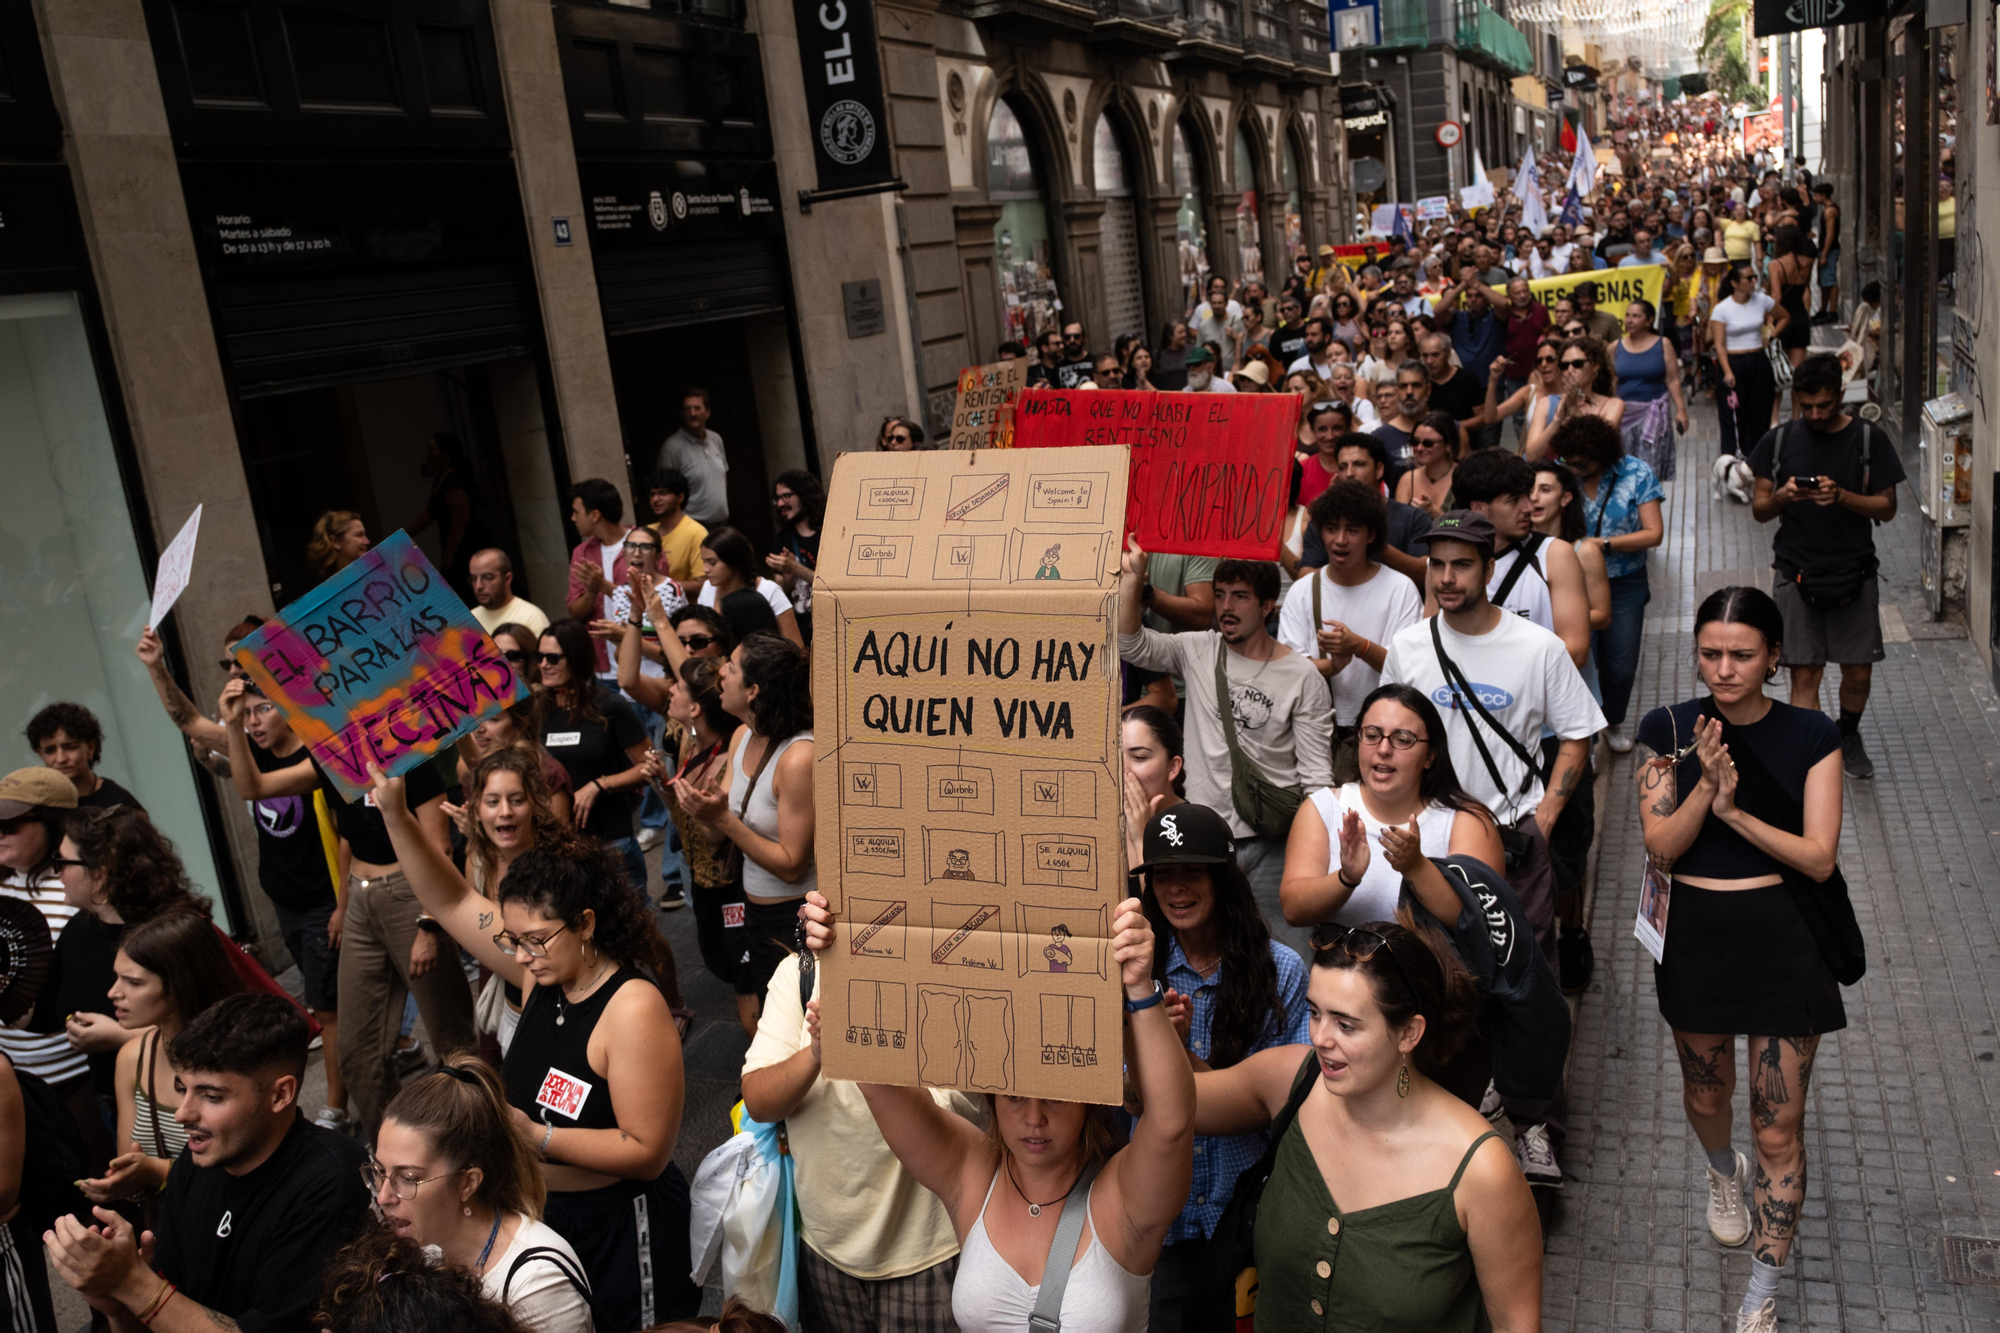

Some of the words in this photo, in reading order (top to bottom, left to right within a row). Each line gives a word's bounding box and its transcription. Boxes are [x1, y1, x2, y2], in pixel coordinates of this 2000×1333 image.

[220, 229, 252, 239] Martes
[253, 230, 259, 238] a
[556, 224, 569, 238] 43
[222, 243, 237, 254] De
[239, 244, 249, 253] 10
[250, 244, 257, 252] a
[276, 243, 282, 253] y
[283, 241, 295, 251] de
[314, 240, 324, 249] 20
[324, 238, 331, 248] h
[1595, 279, 1645, 305] GNAS
[982, 372, 1001, 388] CAE
[1008, 368, 1020, 382] EL
[988, 411, 1000, 424] EL
[1024, 398, 1072, 416] HASTA
[1090, 400, 1116, 418] QUE
[1120, 402, 1142, 420] NO
[1208, 403, 1230, 423] EL
[1084, 426, 1188, 448] RENTISMO
[1043, 487, 1076, 496] Welcome
[1080, 486, 1088, 494] to
[1048, 496, 1074, 506] Spain!
[1158, 460, 1283, 543] OKUPANDO
[261, 649, 306, 687] EL
[303, 562, 430, 658] BARRIO
[314, 638, 400, 708] PARA
[390, 606, 448, 652] LAS
[853, 620, 954, 678] AQUÍ
[968, 638, 1020, 680] NO
[1031, 638, 1095, 682] HAY
[324, 640, 512, 777] VECINAS
[1244, 690, 1274, 708] NOW
[863, 694, 974, 736] QUIEN
[994, 697, 1074, 740] VIVA
[1159, 814, 1183, 847] Sox
[1039, 845, 1050, 853] SE
[1057, 847, 1088, 856] ALQUILA
[1046, 859, 1071, 868] 1.650€
